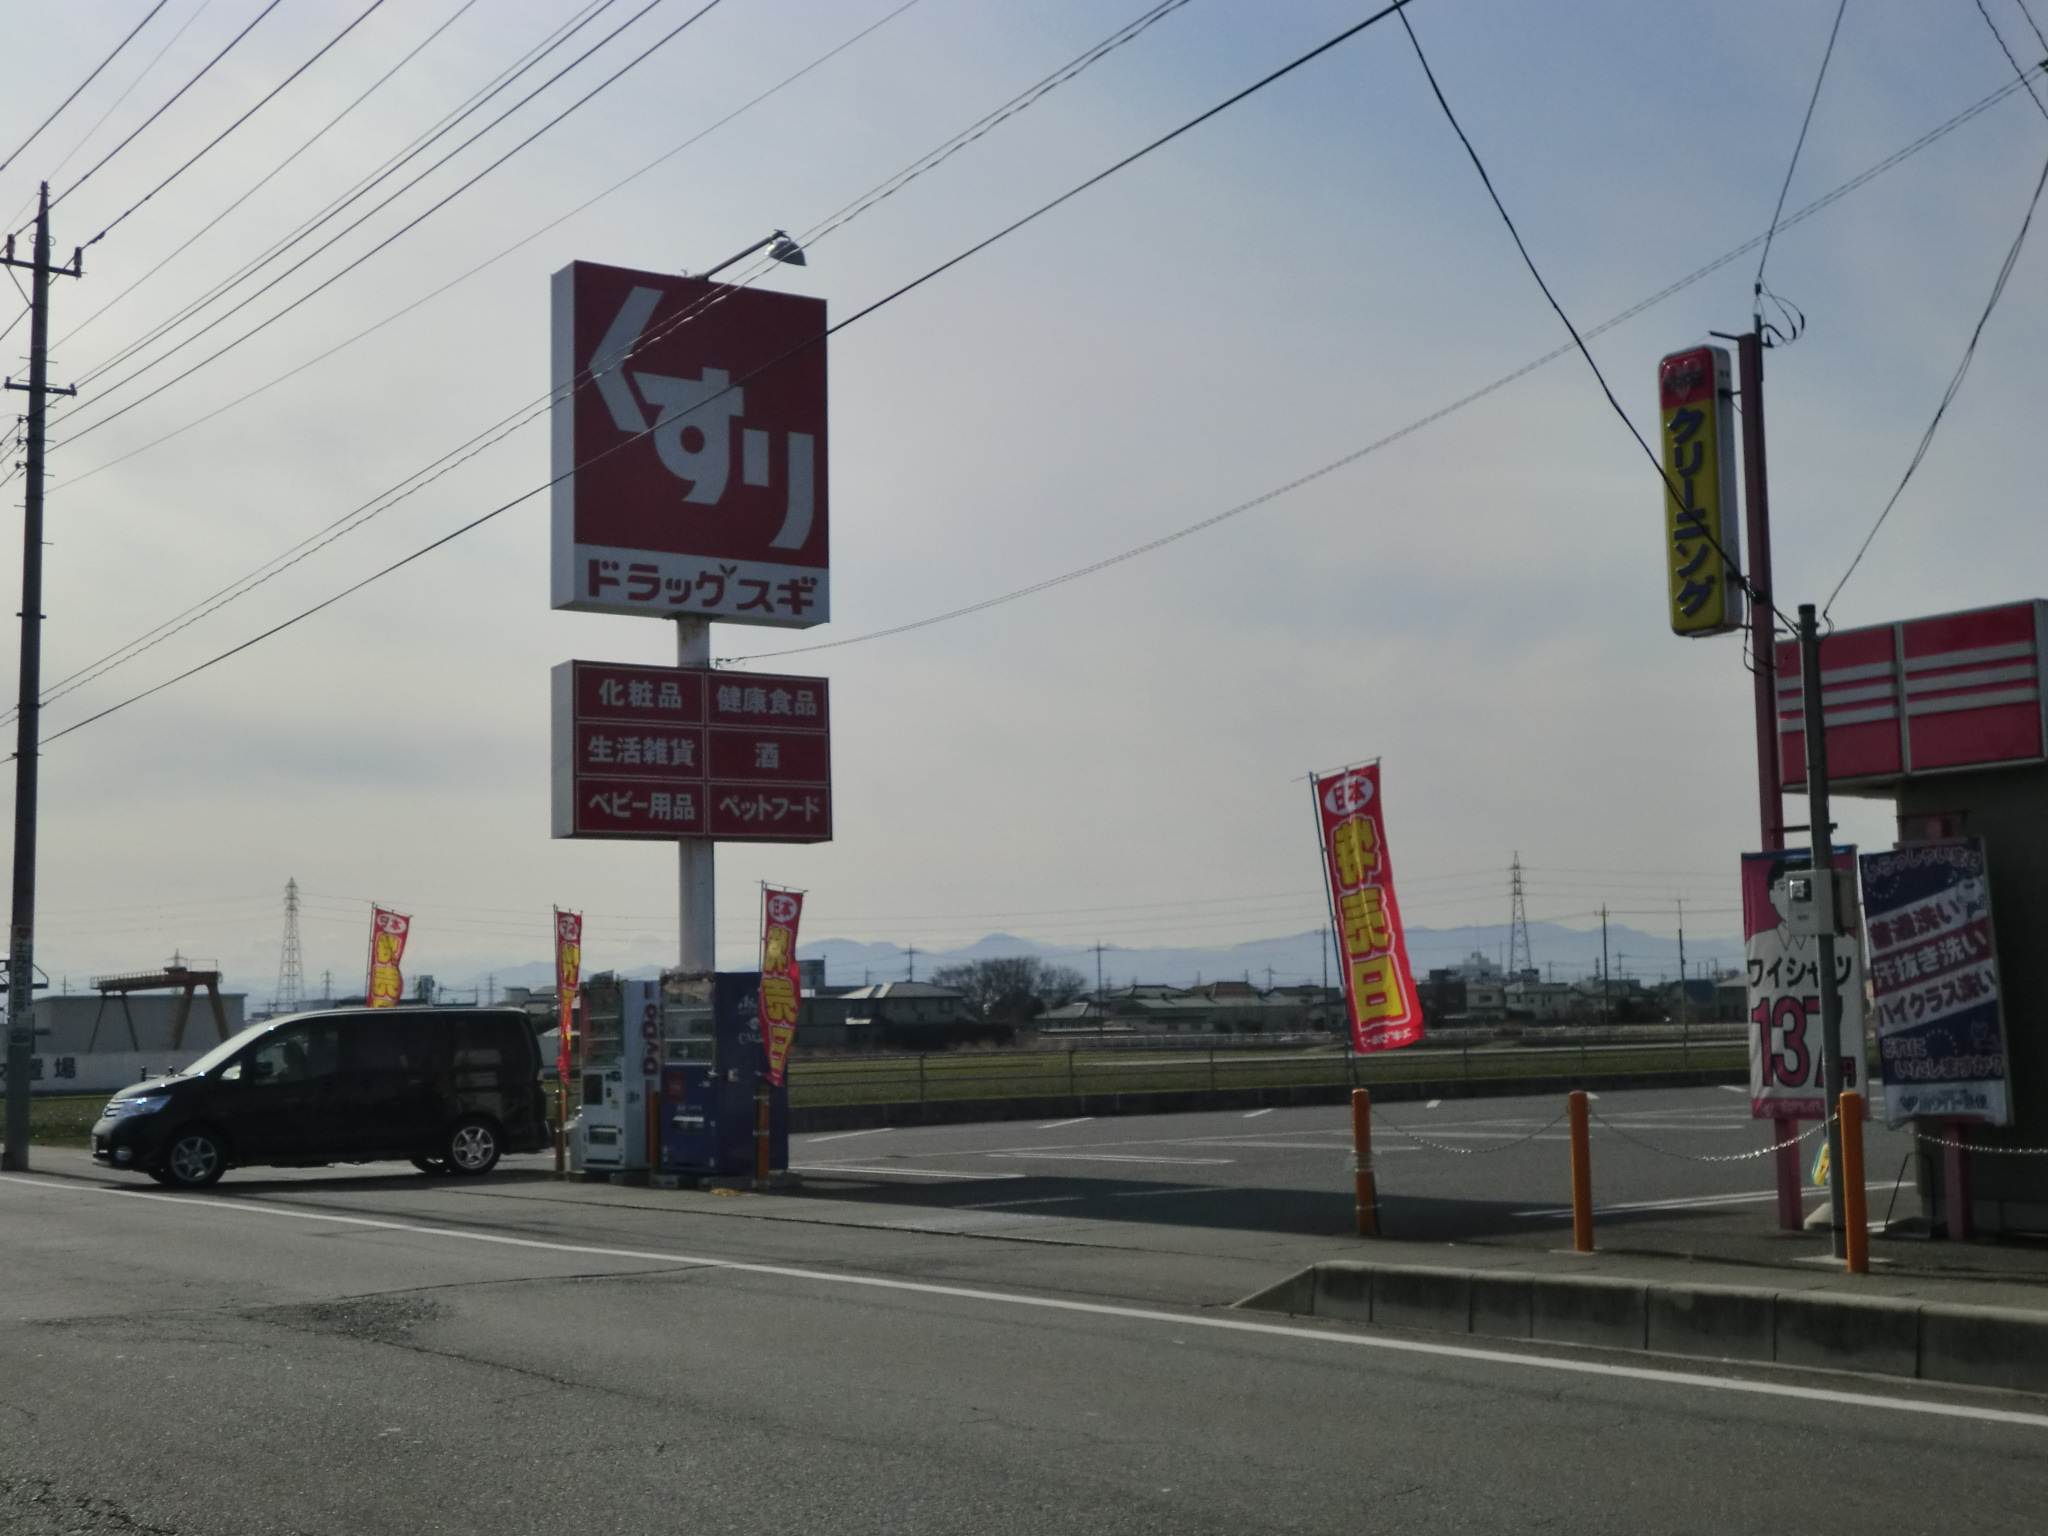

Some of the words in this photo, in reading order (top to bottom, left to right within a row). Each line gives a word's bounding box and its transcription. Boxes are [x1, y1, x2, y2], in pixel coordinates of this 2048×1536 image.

[588, 286, 815, 550] くすり
[1669, 407, 1716, 618] クリーニング
[587, 559, 818, 615] ドラッグスギ
[599, 679, 682, 709] 化粧品
[716, 685, 818, 716] 健康食品
[588, 735, 695, 766] 生活雑貨
[755, 742, 780, 769] 酒
[588, 790, 696, 820] ベビー用品
[719, 795, 820, 822] ペットフード
[1873, 931, 1988, 987] 汗抜き洗い
[1878, 967, 1996, 1027] ハイクラス洗い
[642, 1002, 659, 1076] DyDo
